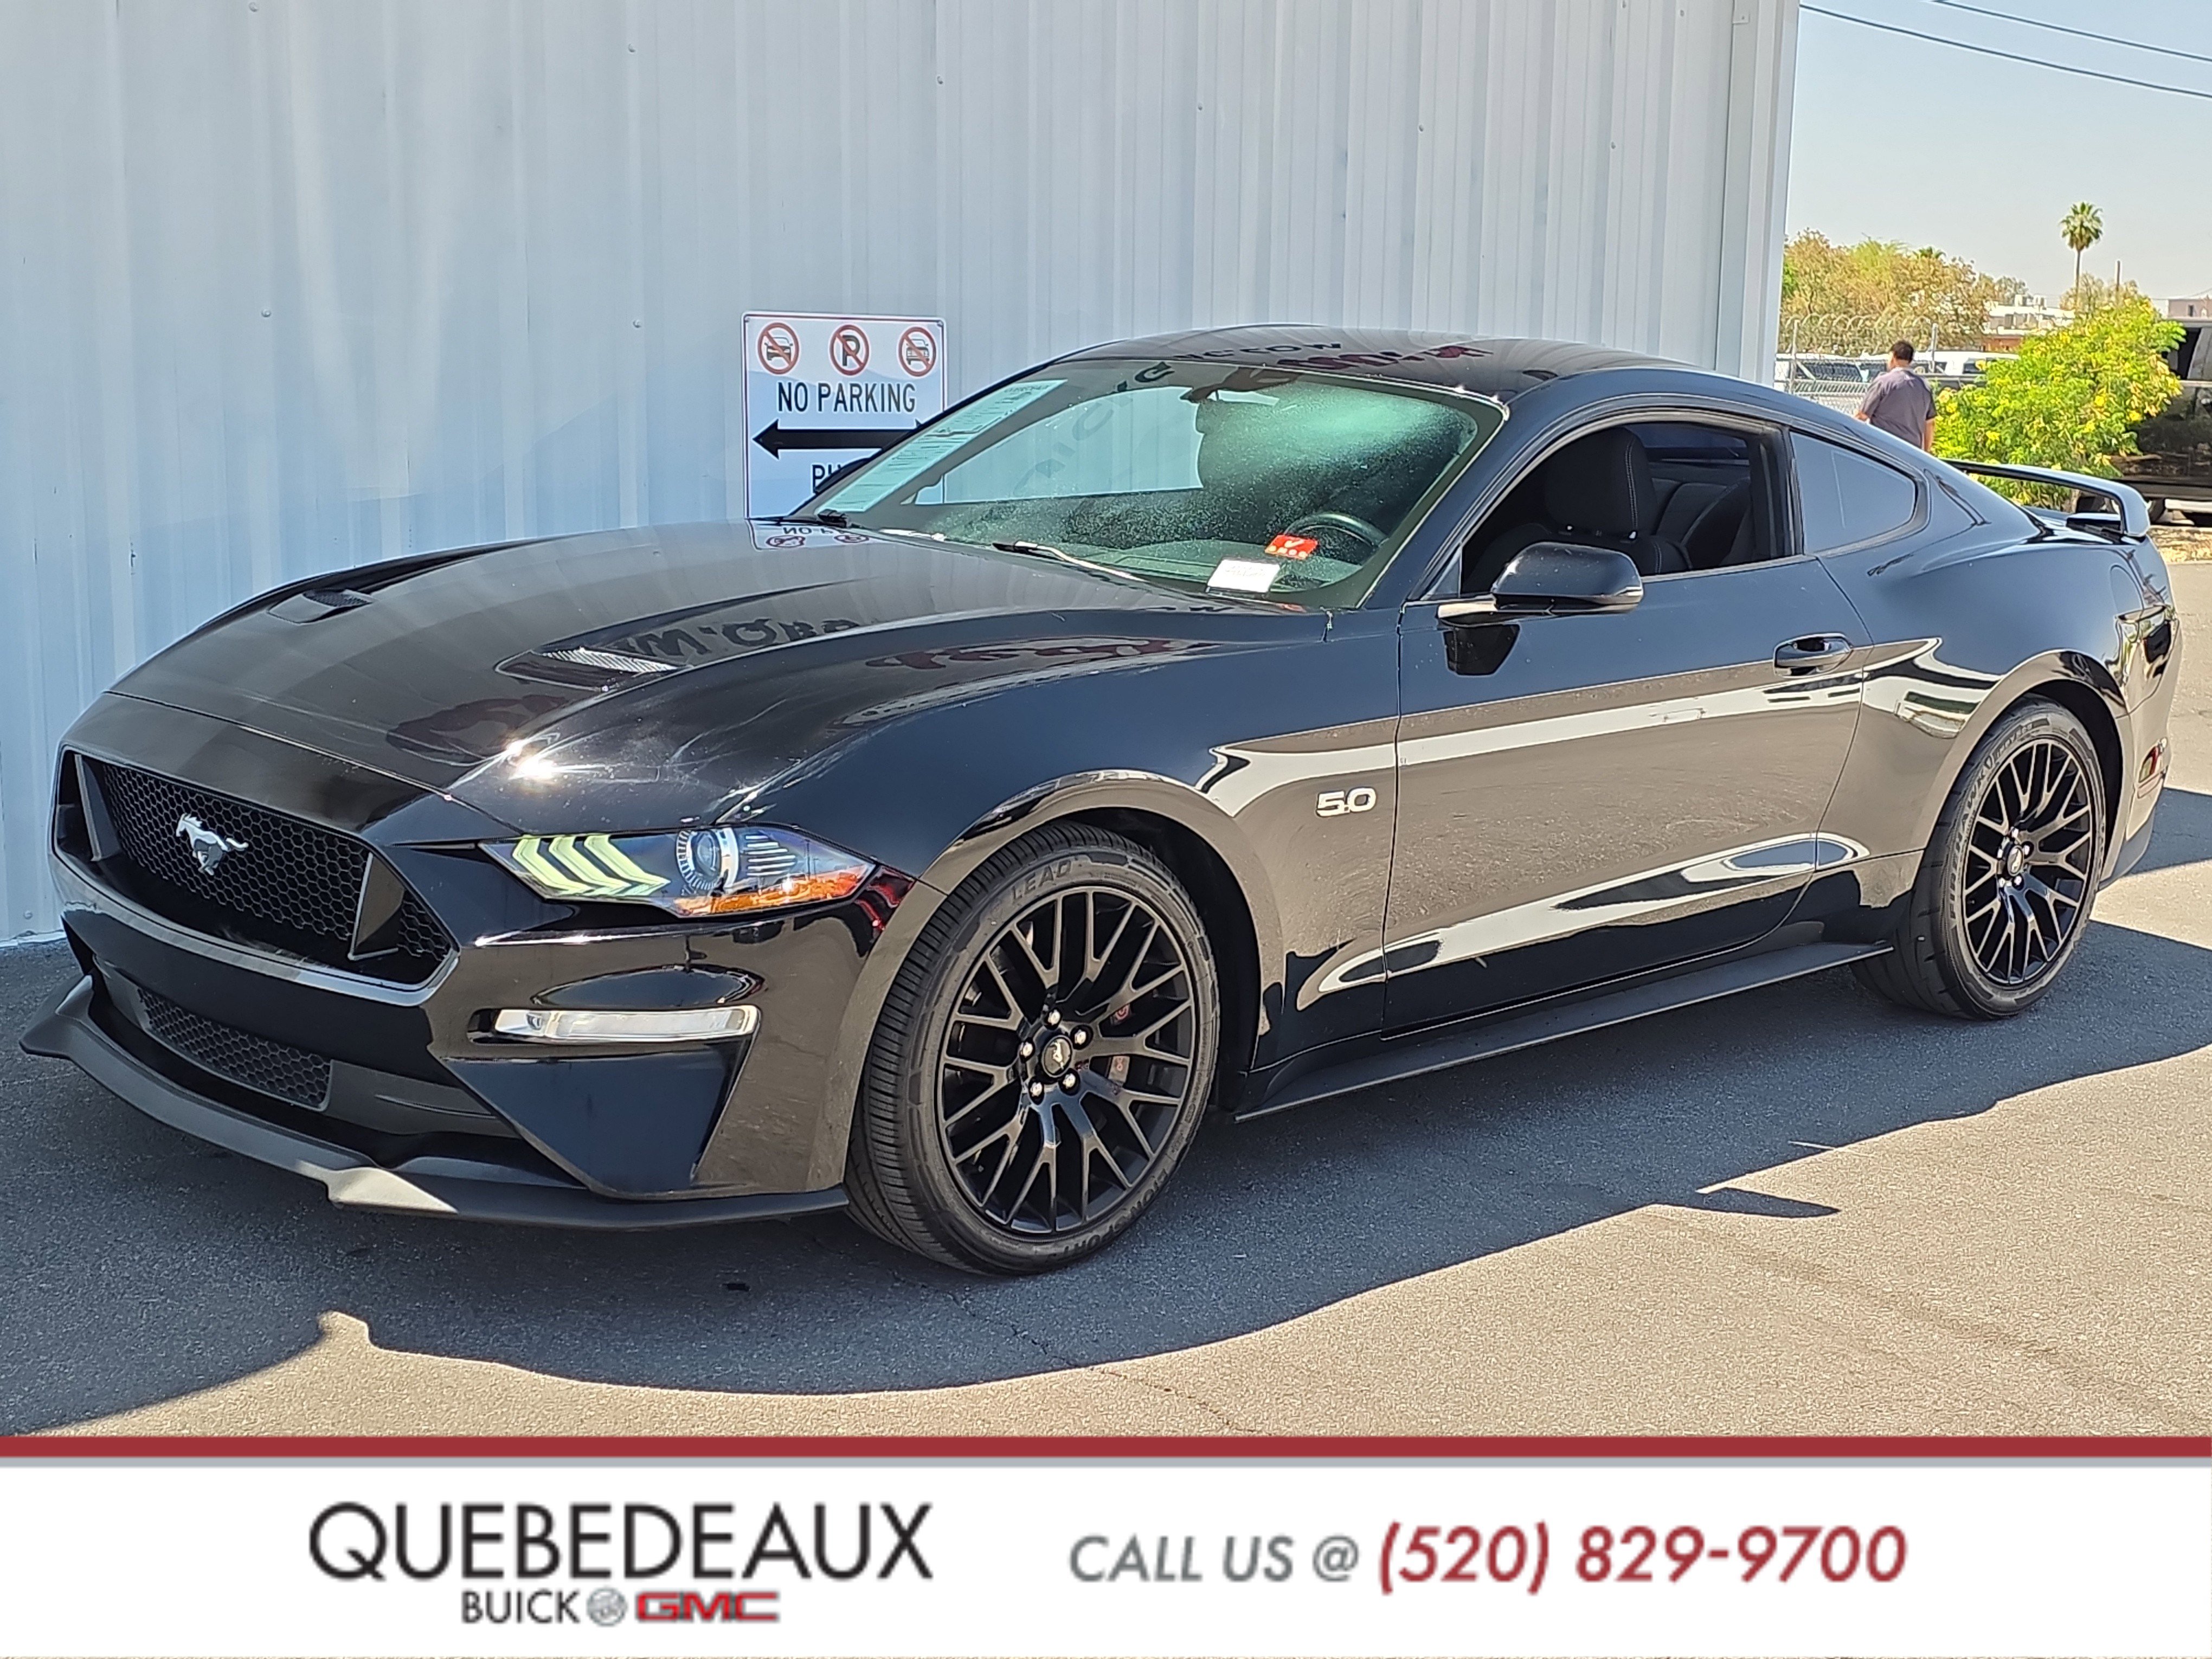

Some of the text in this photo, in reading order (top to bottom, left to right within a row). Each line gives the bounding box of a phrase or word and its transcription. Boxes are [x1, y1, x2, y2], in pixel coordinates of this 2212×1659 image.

[777, 382, 915, 413] NO PARKING
[1316, 787, 1377, 817] 5.0
